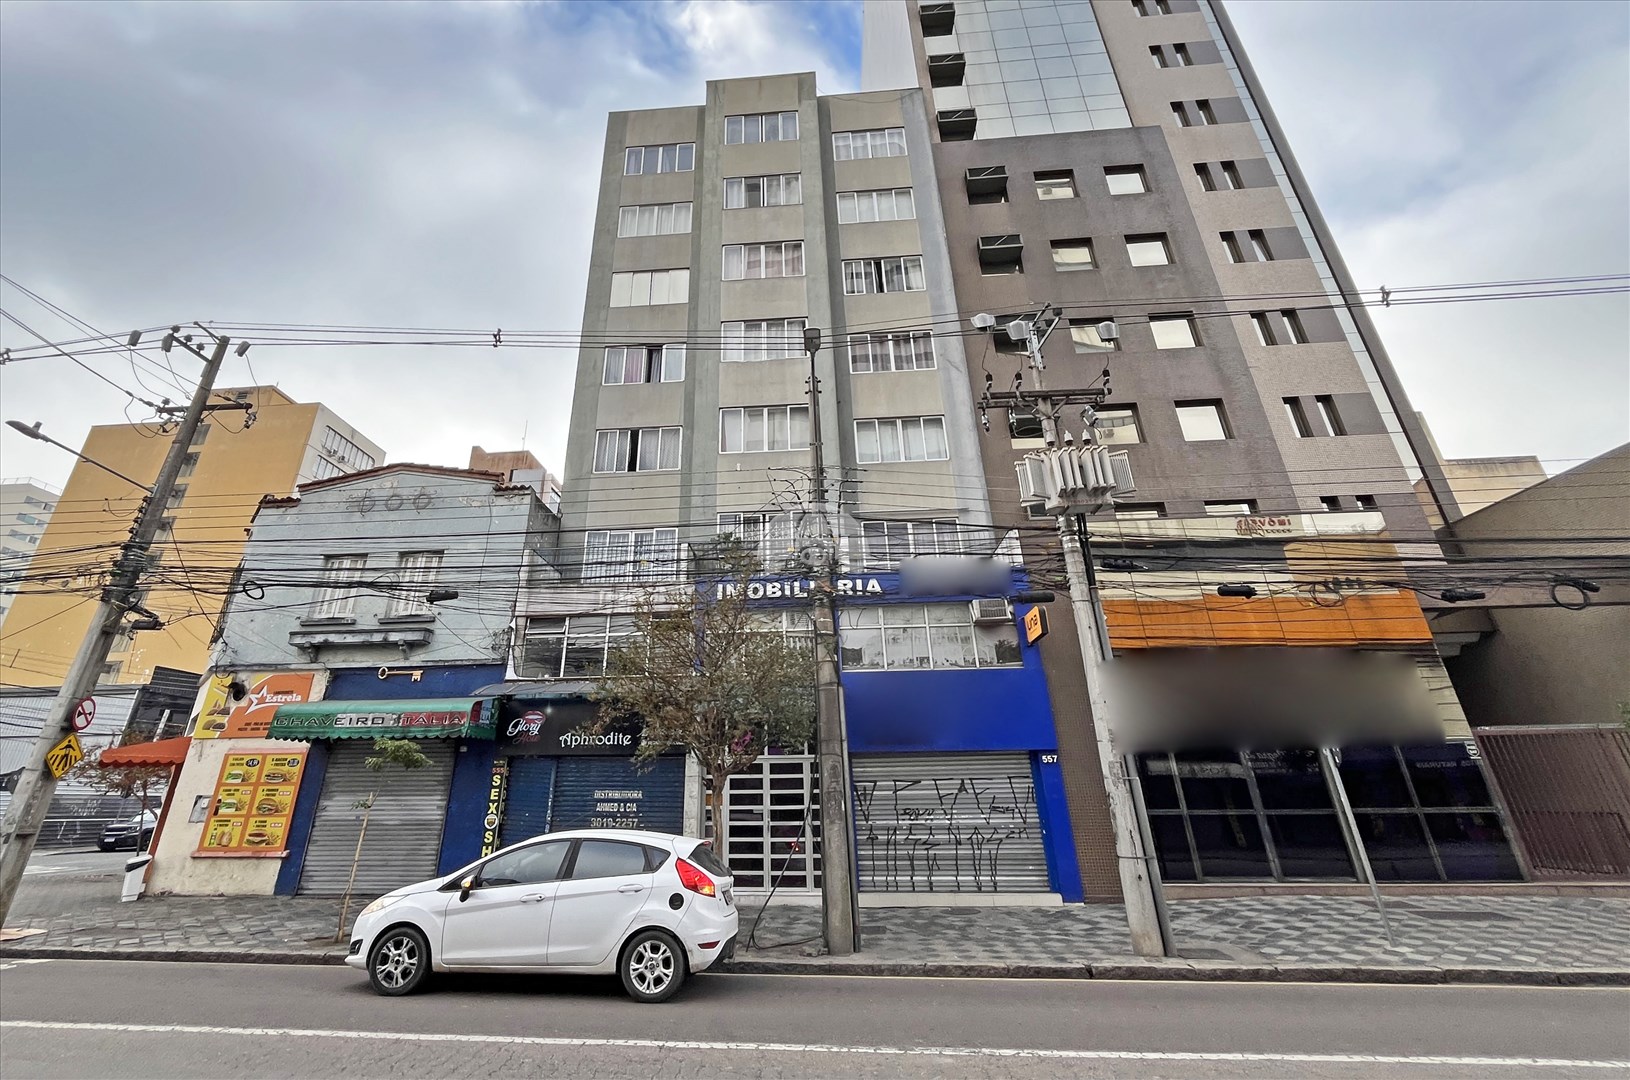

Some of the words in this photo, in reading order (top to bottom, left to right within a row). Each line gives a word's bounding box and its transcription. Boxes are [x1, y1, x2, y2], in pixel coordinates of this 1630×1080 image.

[265, 693, 302, 703] Estrela
[274, 711, 385, 728] CHAVEIRO
[506, 718, 542, 736] Glory
[559, 732, 632, 749] Aphrodite
[1041, 755, 1058, 763] 557
[594, 790, 643, 799] DISTRIBUIDORA
[595, 803, 619, 812] AHMED
[626, 803, 637, 812] CIA
